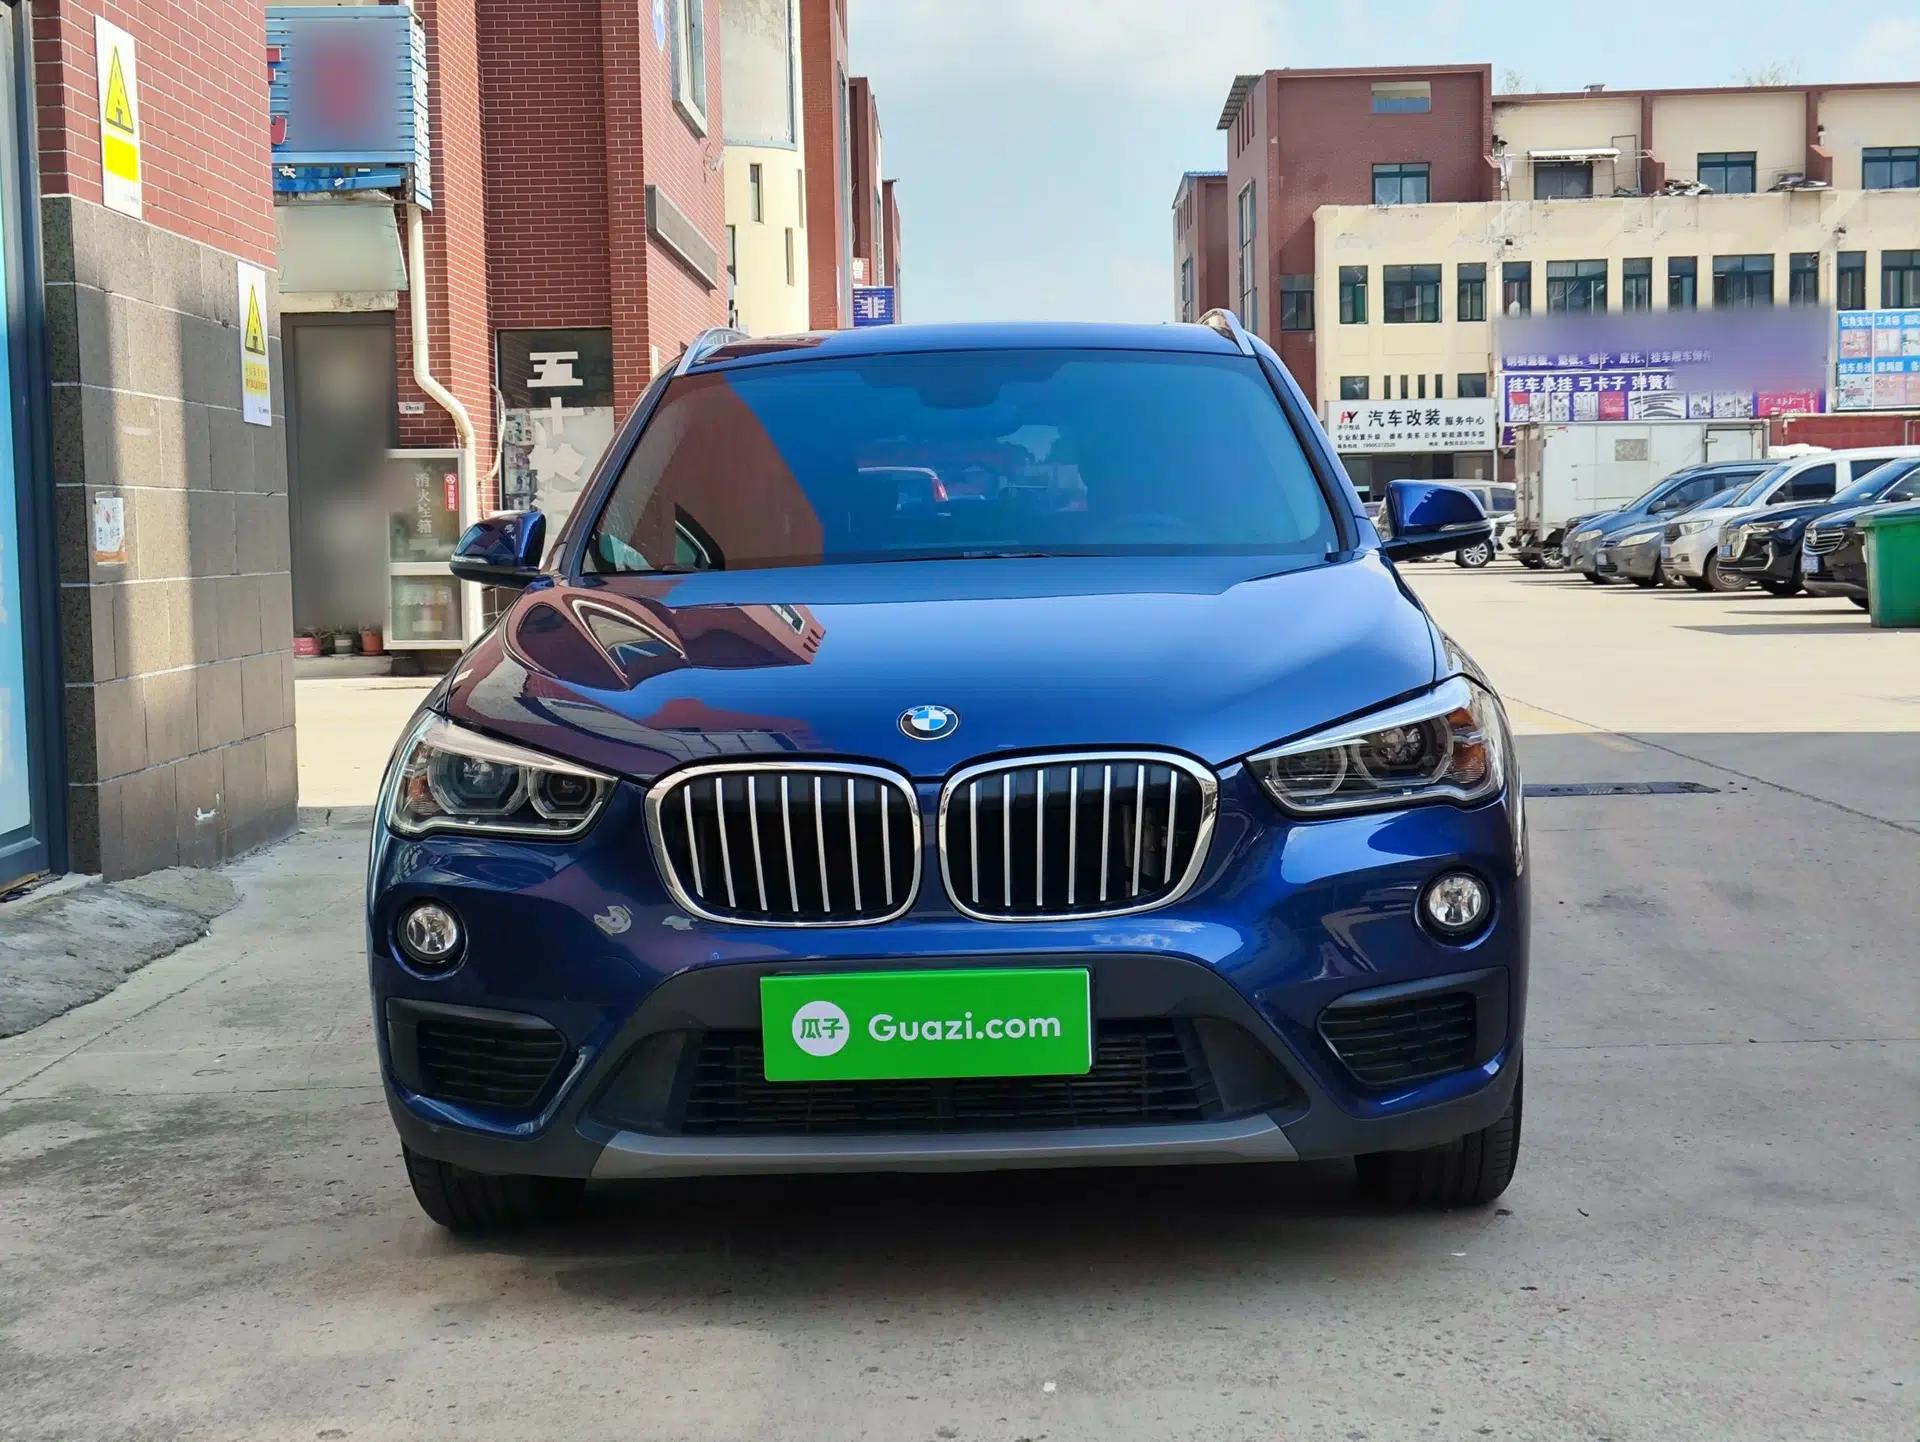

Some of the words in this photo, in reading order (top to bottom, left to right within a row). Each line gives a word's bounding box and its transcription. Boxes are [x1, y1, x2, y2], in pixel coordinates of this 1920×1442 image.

[1508, 376, 1573, 393] 挂车悬挂
[1578, 376, 1626, 392] 弓卡子
[1340, 410, 1359, 424] HY
[1368, 408, 1441, 427] 汽车改装
[1445, 415, 1486, 426] 服务中心
[800, 1018, 843, 1039] 瓜子
[868, 1011, 1061, 1041] Guazi.com
